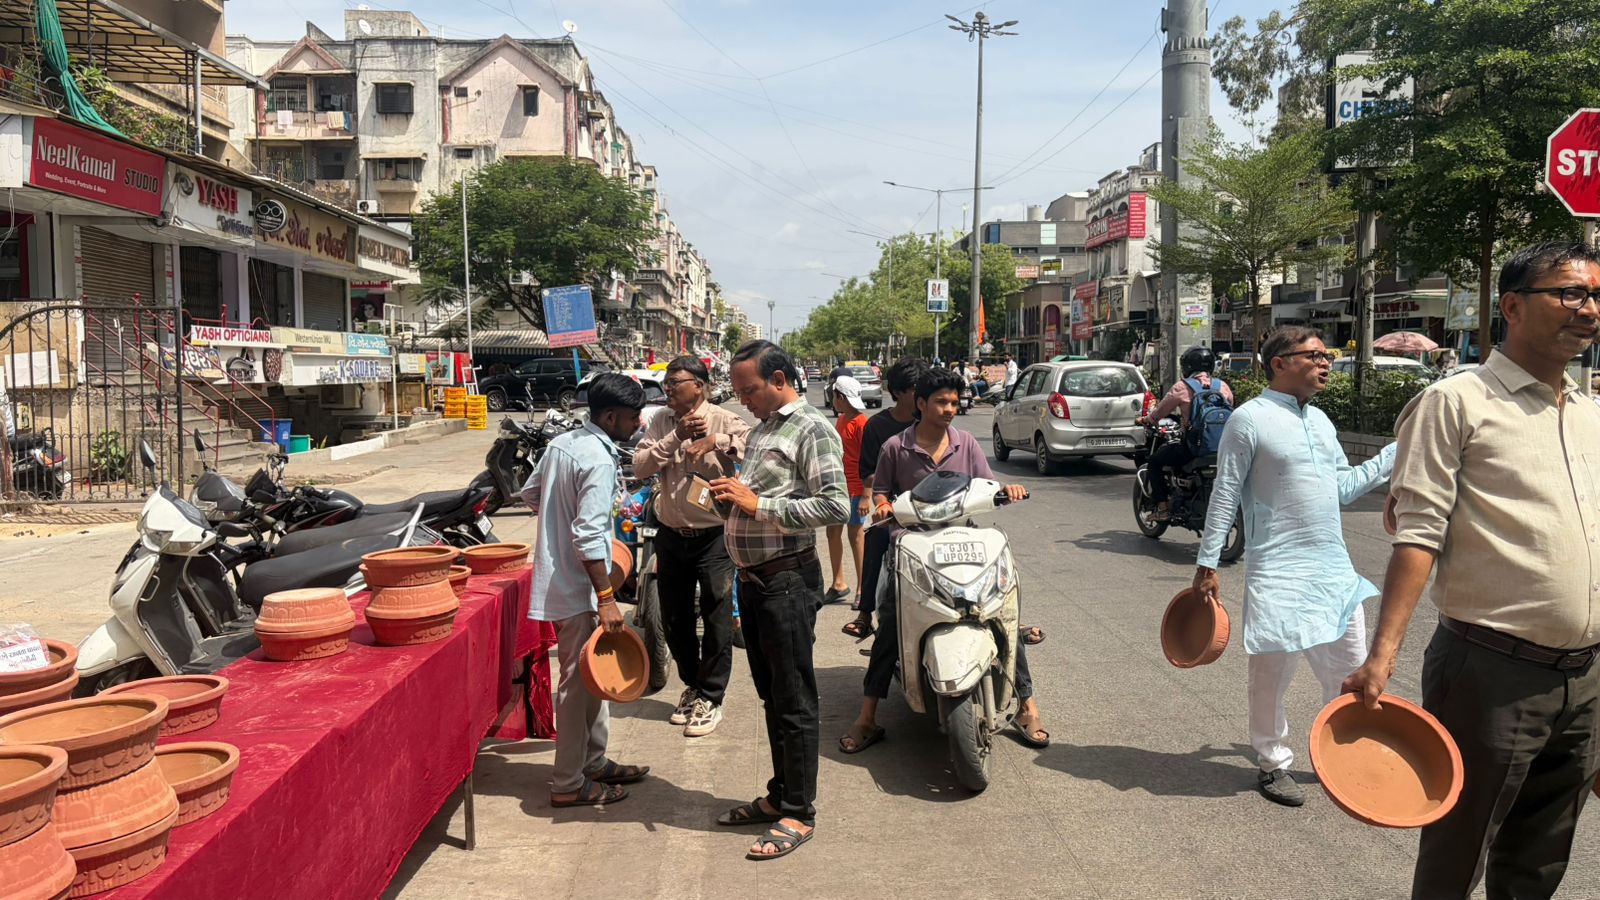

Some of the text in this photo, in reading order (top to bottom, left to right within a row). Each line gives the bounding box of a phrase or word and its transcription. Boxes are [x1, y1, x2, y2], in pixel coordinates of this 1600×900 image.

[36, 135, 159, 193] NeelKamal STUDIO
[1557, 148, 1600, 176] ST
[195, 176, 239, 214] YASH
[195, 326, 270, 343] YASH OPTICIANS
[944, 552, 984, 563] UP0295
[949, 543, 975, 553] GJ01
